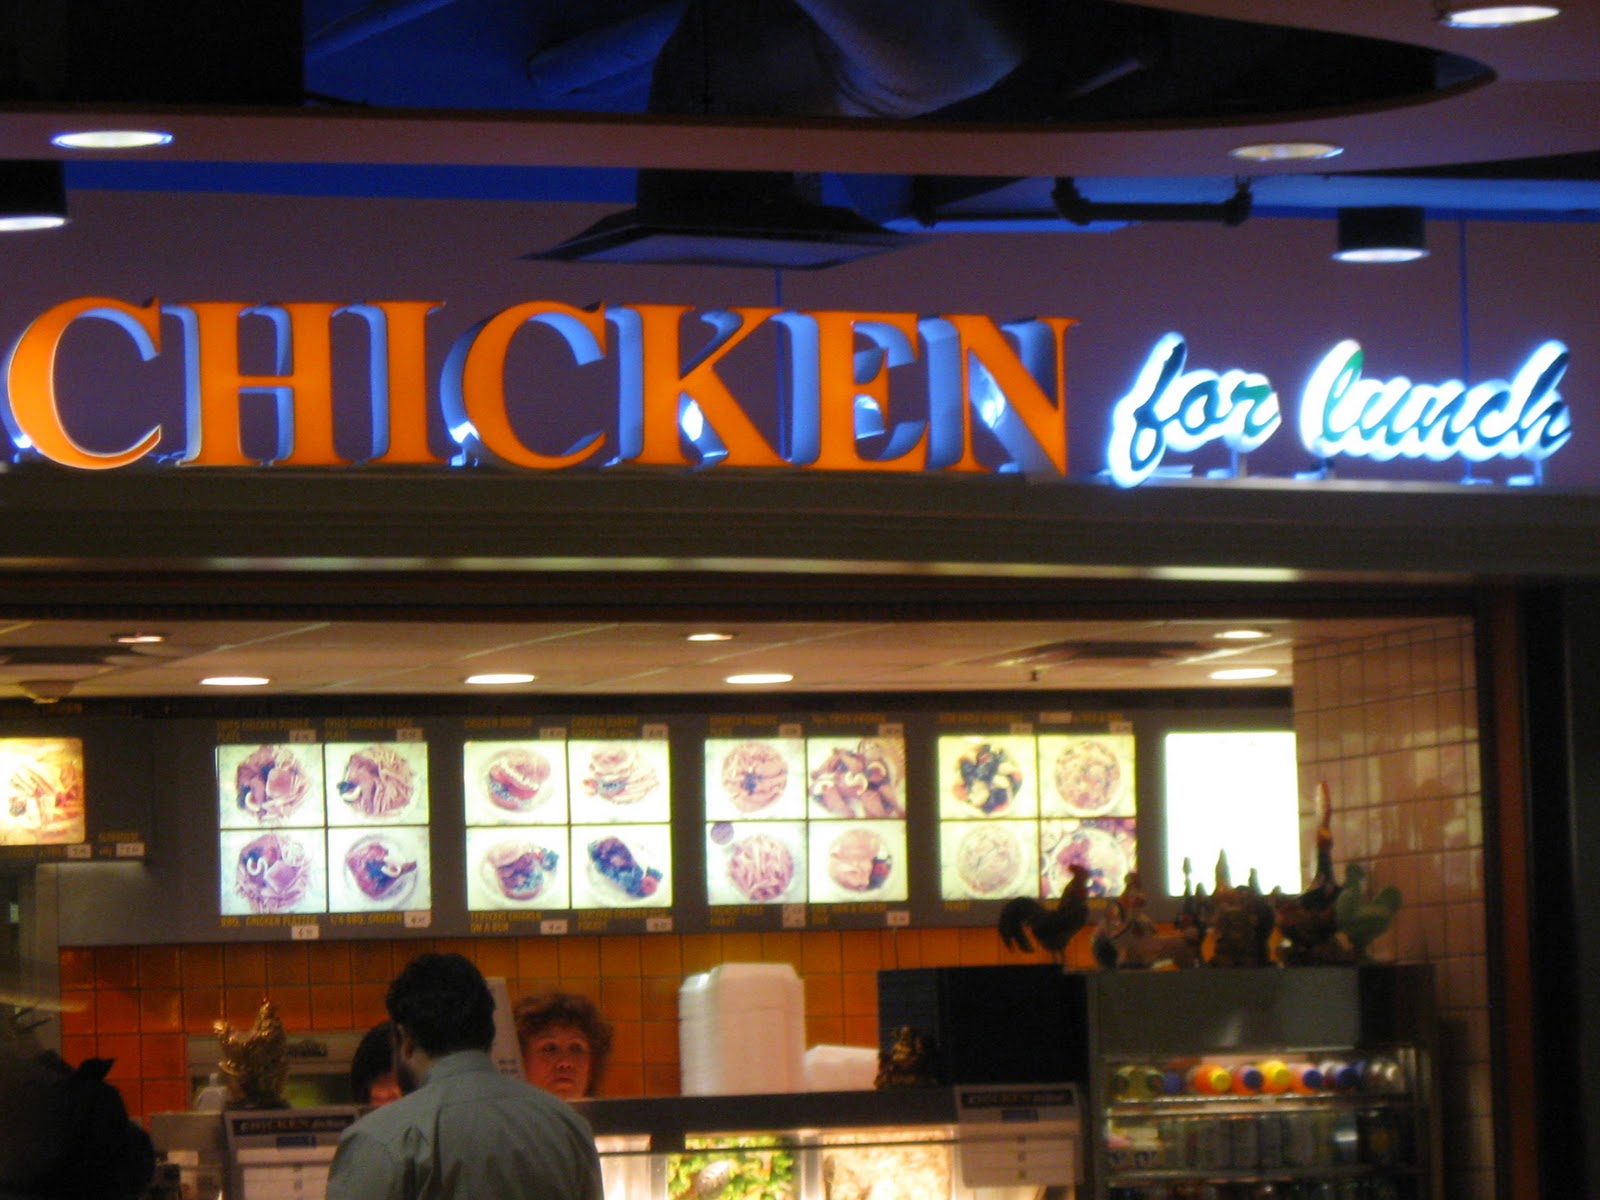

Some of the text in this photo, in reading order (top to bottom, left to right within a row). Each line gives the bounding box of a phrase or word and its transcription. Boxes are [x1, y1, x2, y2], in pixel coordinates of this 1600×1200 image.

[6, 296, 1573, 488] CHICKEN for lunch
